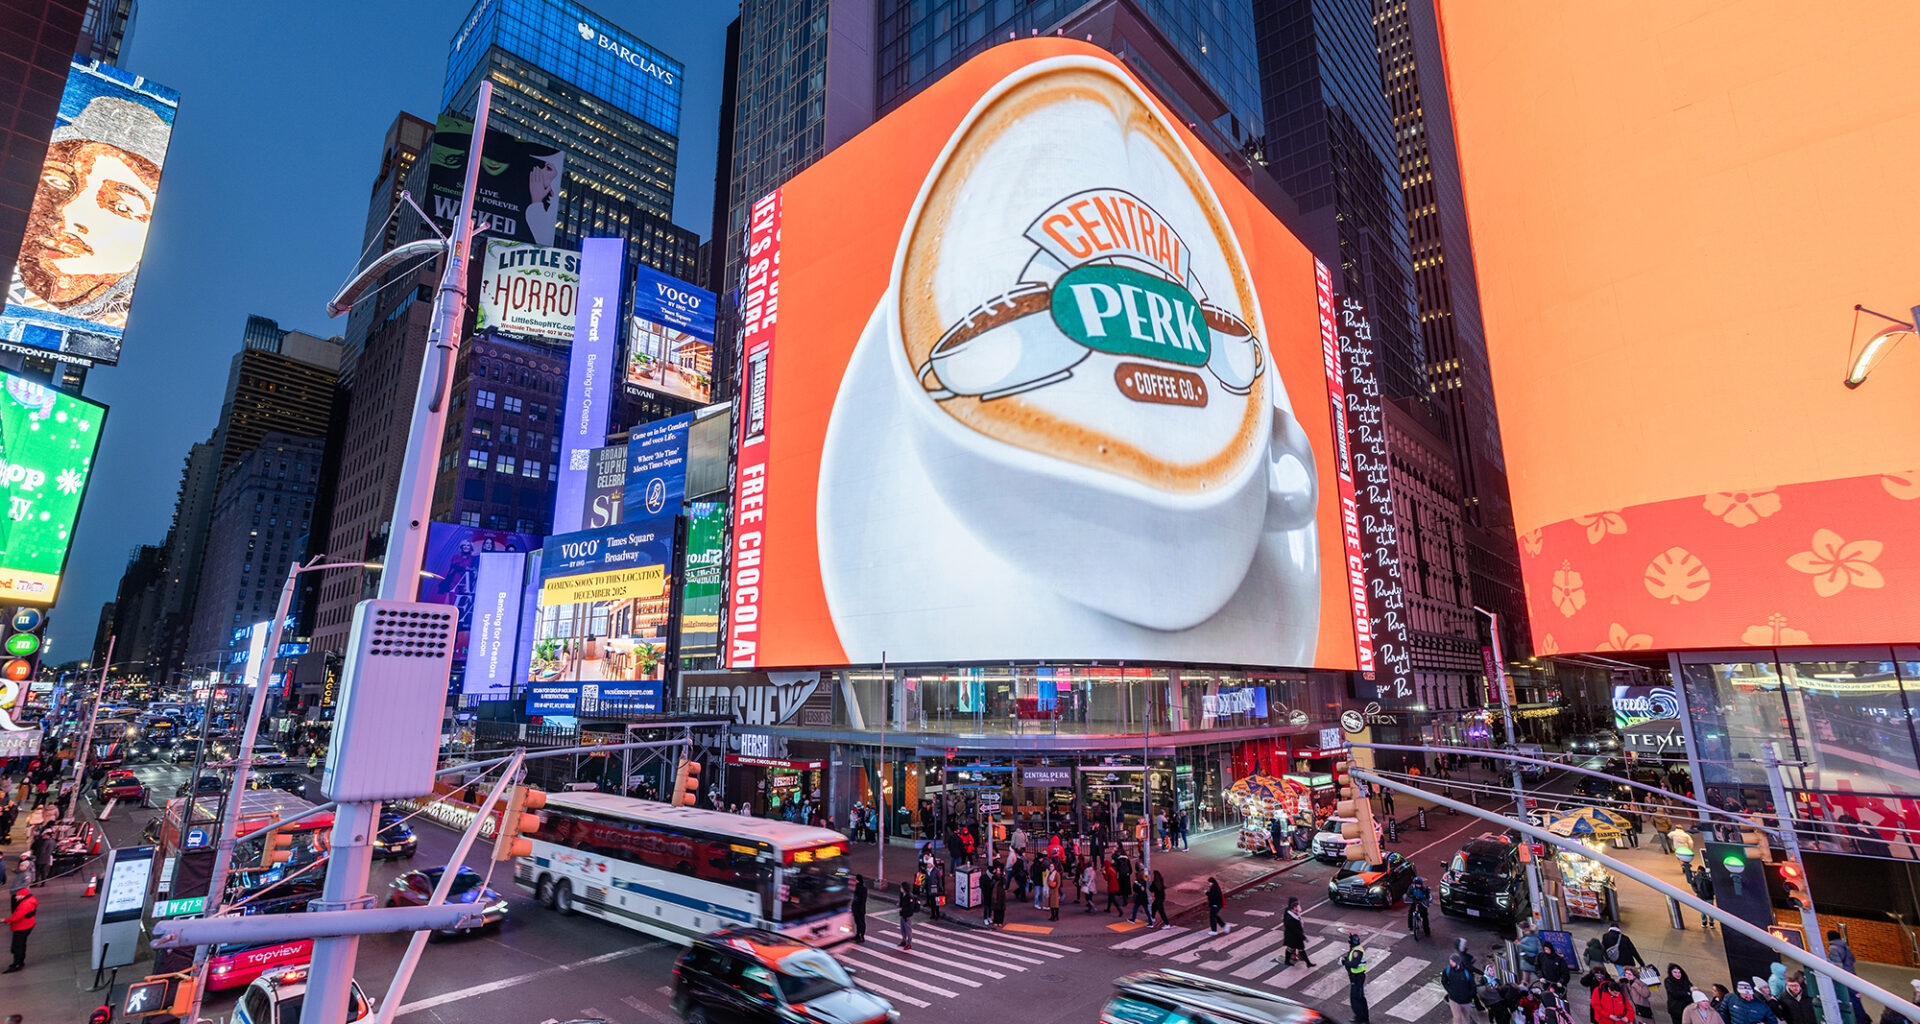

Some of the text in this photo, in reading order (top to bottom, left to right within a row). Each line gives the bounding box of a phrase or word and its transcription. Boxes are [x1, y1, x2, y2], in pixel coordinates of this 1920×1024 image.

[598, 33, 674, 85] BARCLAYS
[434, 194, 517, 235] WCKED
[1042, 196, 1184, 281] CENTRAL
[498, 249, 561, 270] LITTLE
[745, 257, 769, 337] STORE
[588, 308, 602, 342] Karat
[1069, 283, 1206, 353] PERK
[526, 326, 546, 334] Theatre
[1320, 314, 1335, 381] STORE
[1339, 336, 1374, 355] Paradise
[1351, 354, 1371, 366] club
[1350, 366, 1377, 384] Paradi
[626, 386, 654, 400] KEVANI
[1134, 371, 1178, 400] COFFEE
[1359, 411, 1380, 424] club
[667, 421, 688, 433] Comfort
[1358, 425, 1384, 443] Parad
[638, 453, 654, 462] Where
[664, 456, 682, 468] Square
[1368, 470, 1388, 484] club
[740, 462, 766, 525] FREE
[1367, 486, 1391, 504] Parad
[1343, 497, 1359, 550] FREE
[606, 532, 654, 548] Times Square
[1376, 532, 1396, 545] club
[604, 550, 640, 563] Broadway
[547, 569, 662, 591] COMING SOON TO THIS LOCATION
[1372, 578, 1402, 598] Paradi
[574, 586, 627, 600] DECEMBER 2025
[494, 592, 506, 625] Banking
[1384, 612, 1405, 632] Para
[16, 640, 31, 648] m
[1398, 628, 1408, 642] cl
[488, 639, 501, 679] Creators
[1380, 644, 1409, 665] Paradi
[170, 902, 178, 912] W
[180, 900, 192, 912] 47
